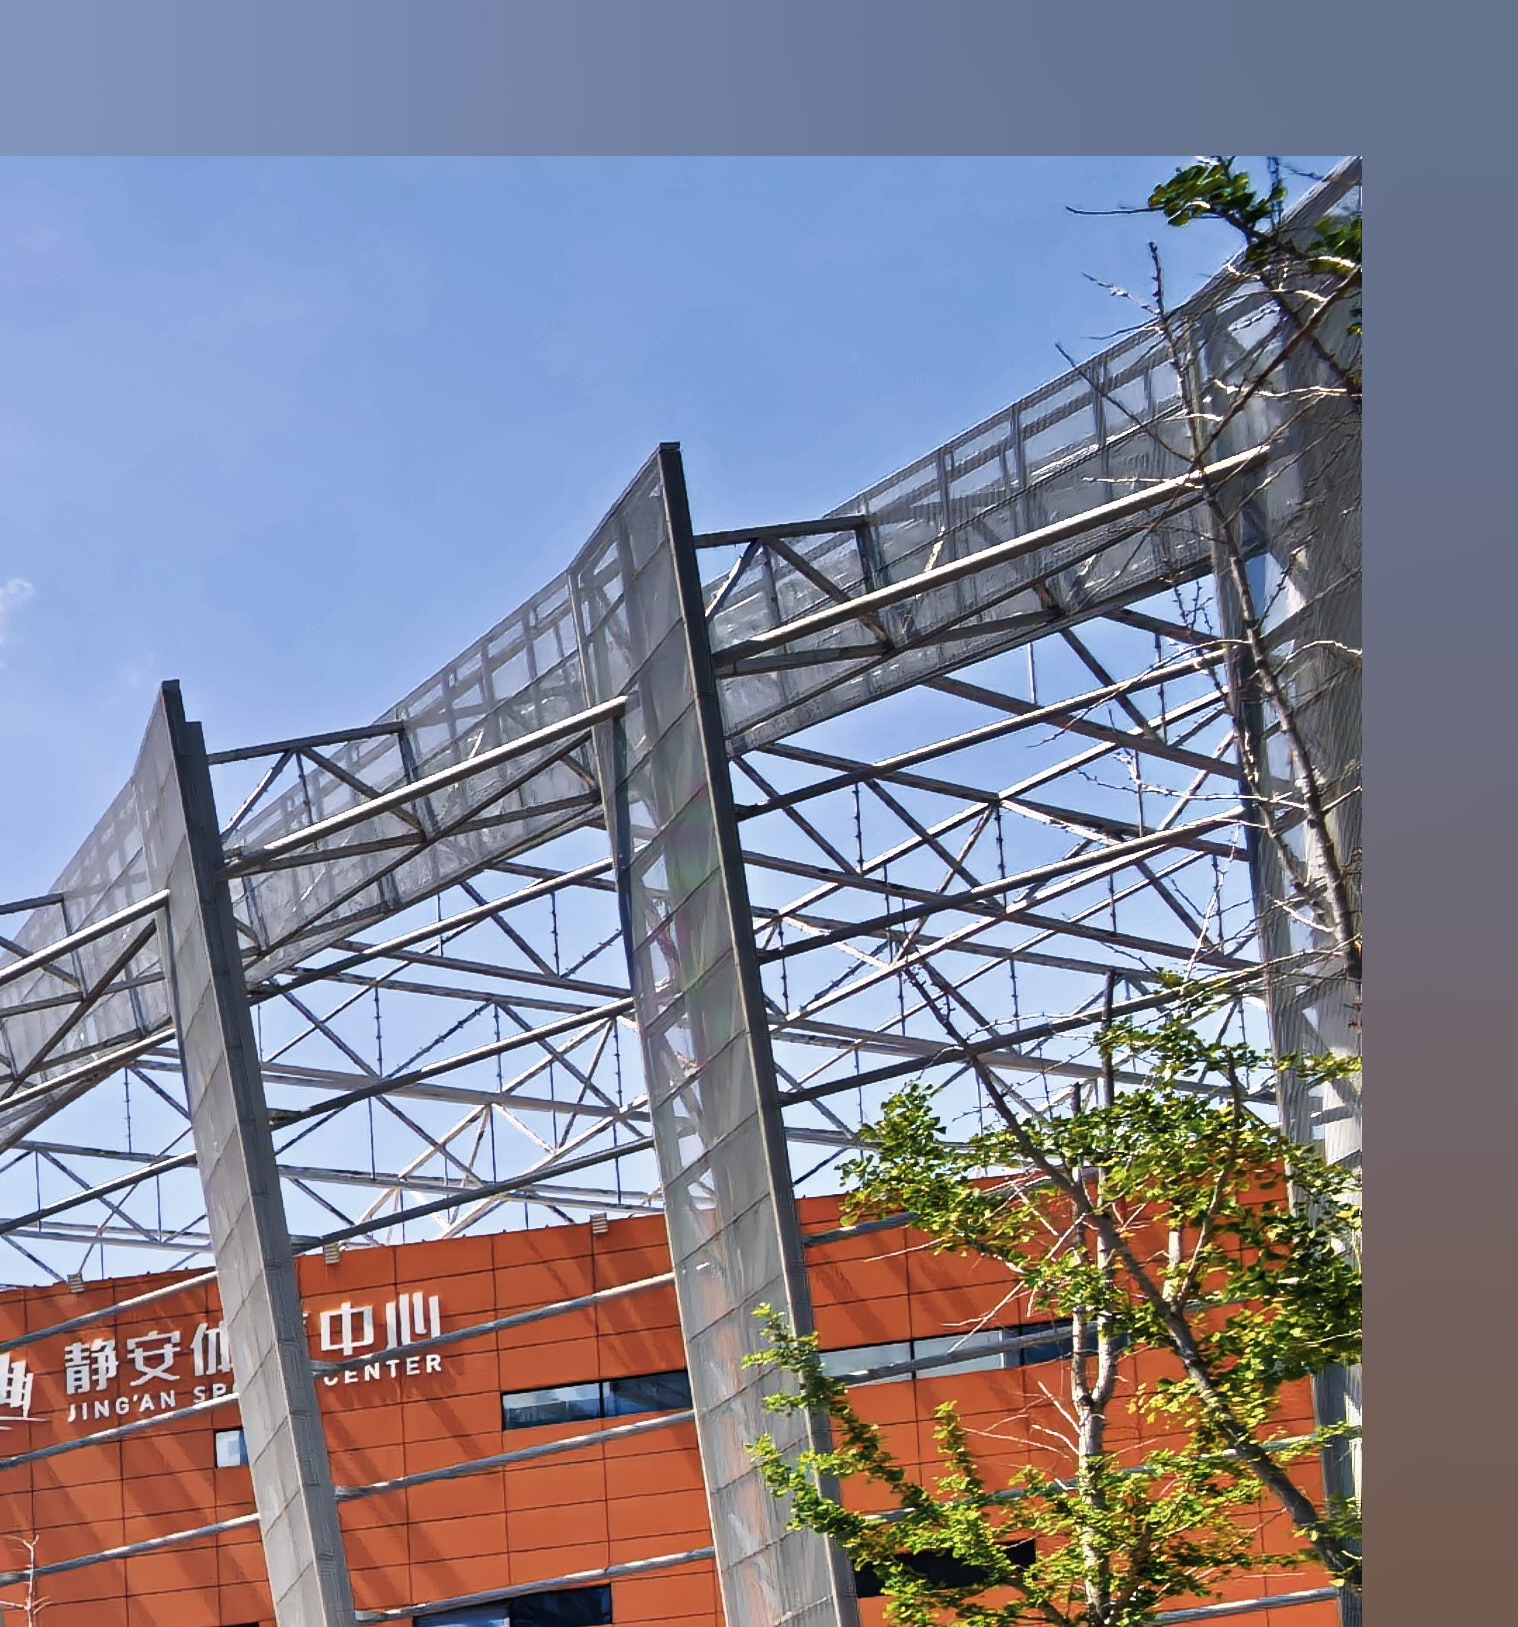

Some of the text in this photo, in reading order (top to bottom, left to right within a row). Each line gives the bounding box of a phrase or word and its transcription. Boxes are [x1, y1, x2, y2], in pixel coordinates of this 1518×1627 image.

[64, 1292, 442, 1395] 静安体中心
[67, 1390, 176, 1423] JING'AN
